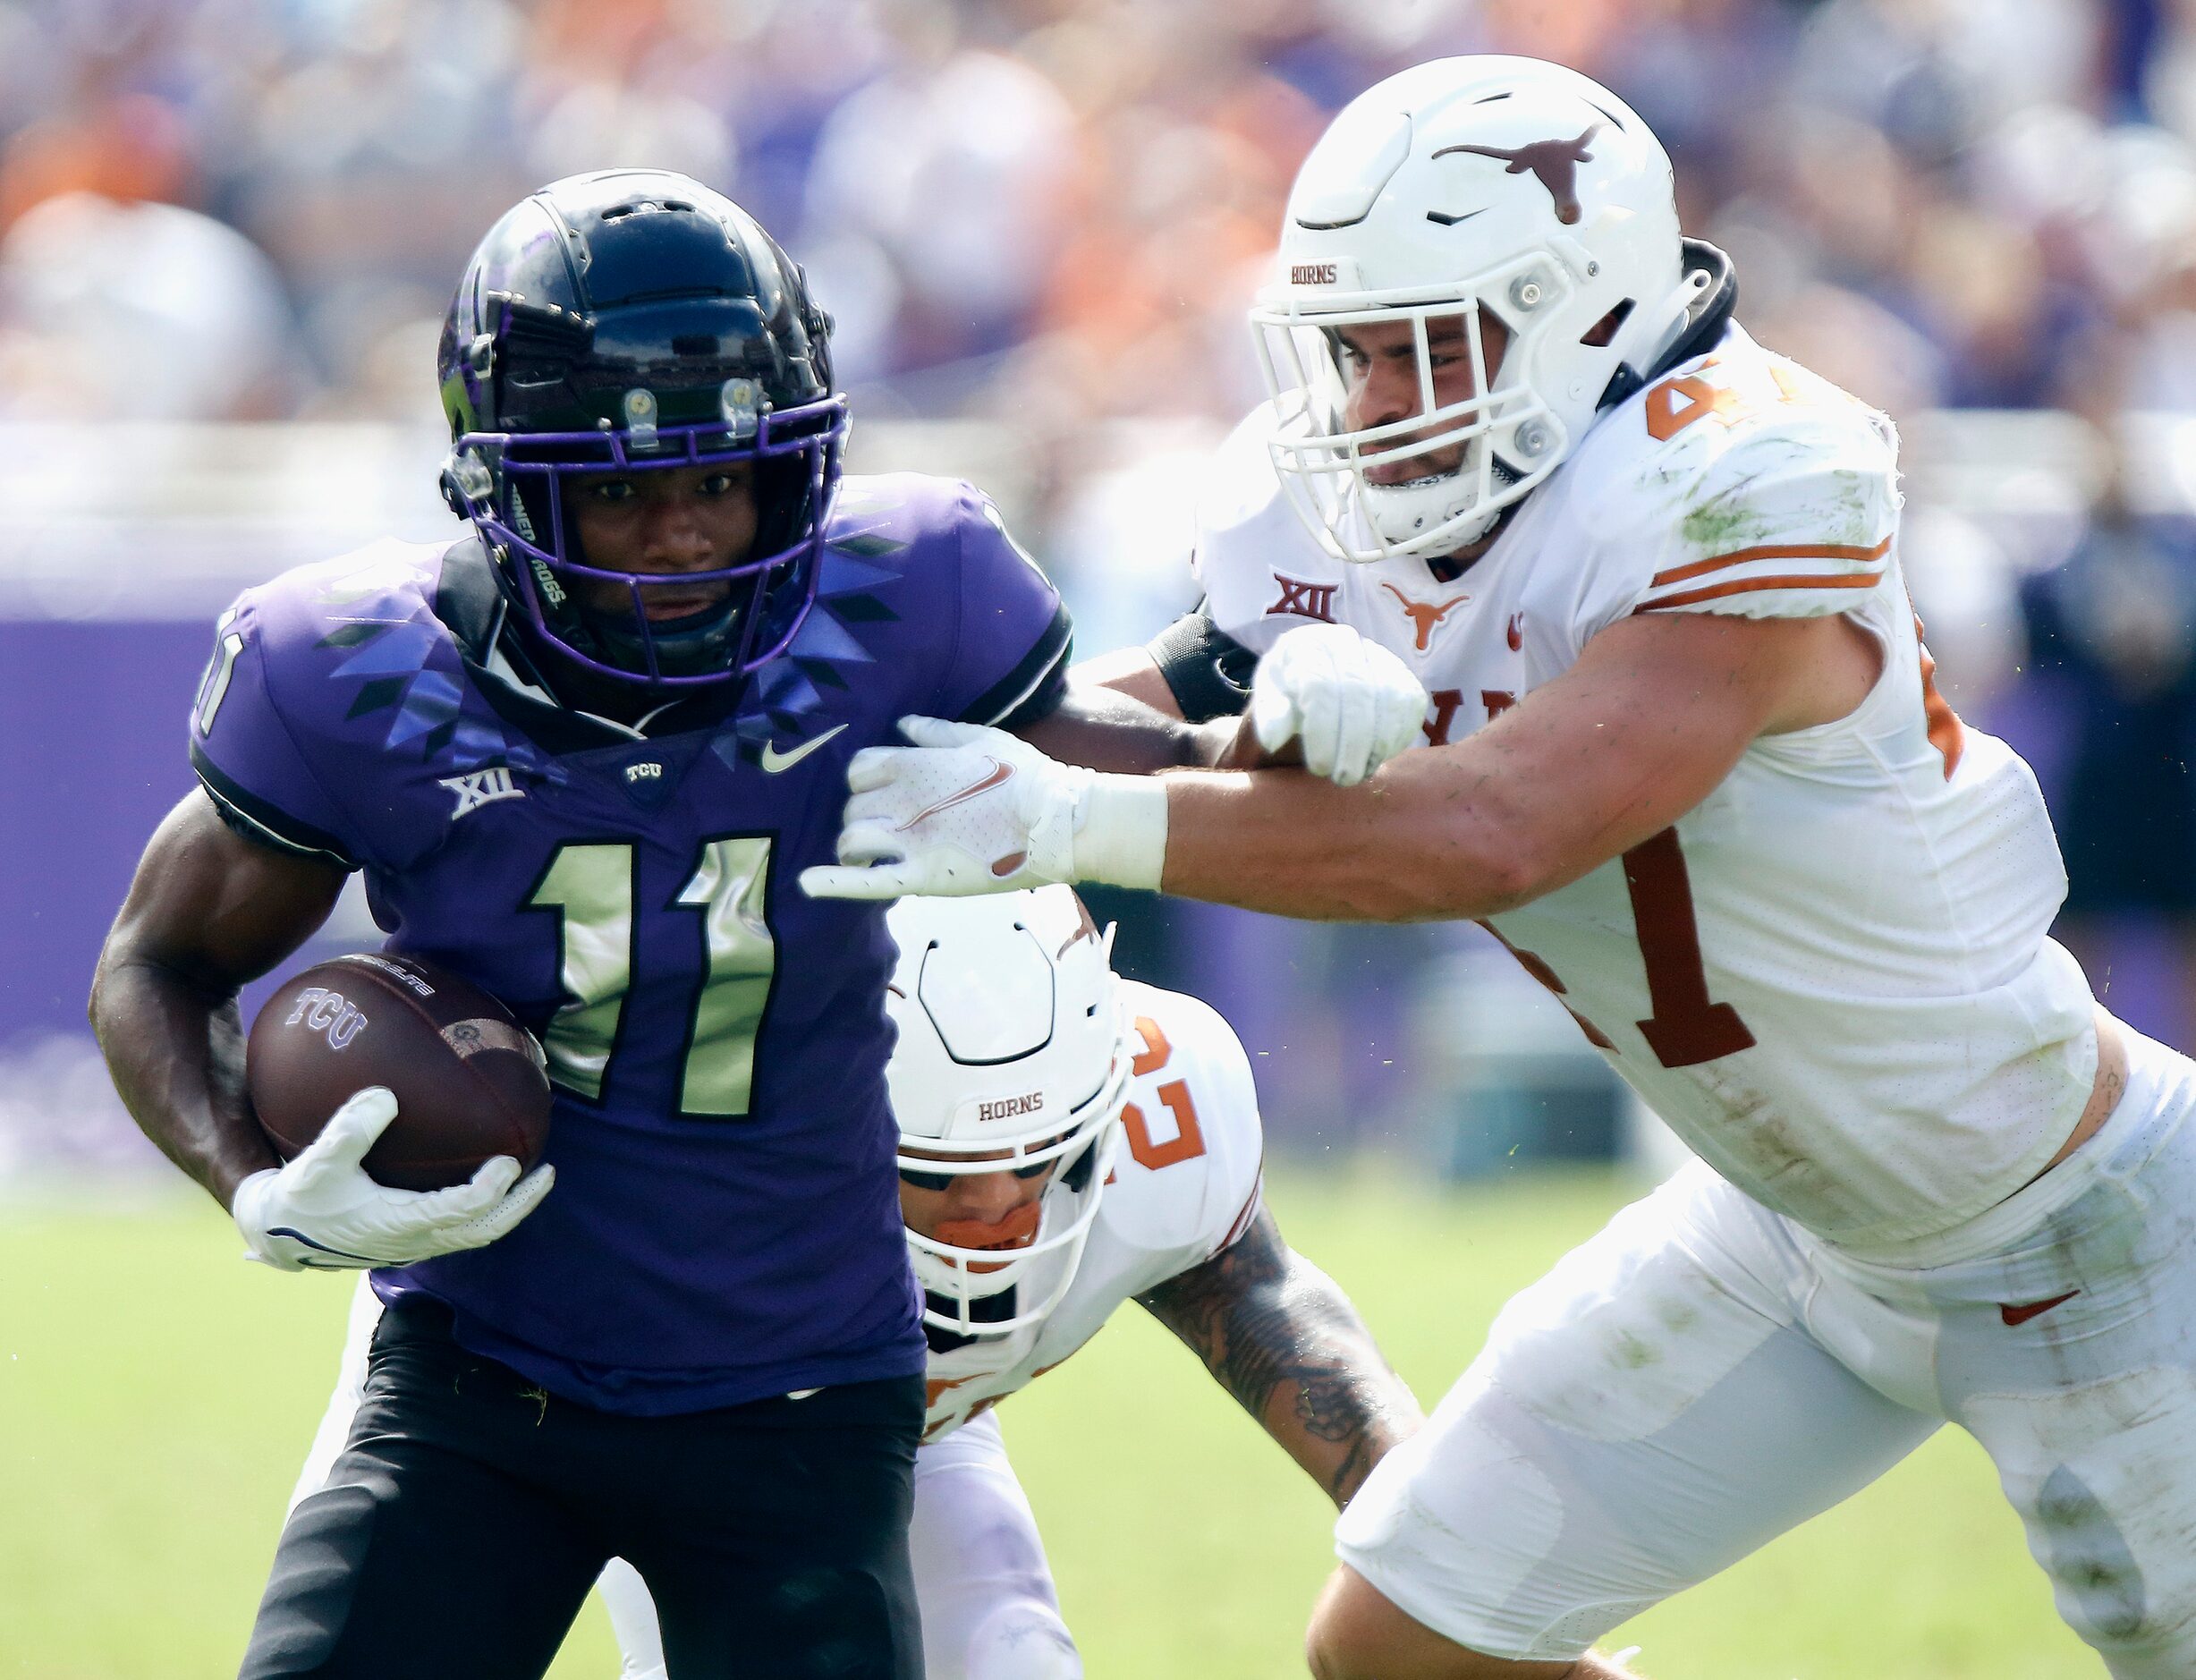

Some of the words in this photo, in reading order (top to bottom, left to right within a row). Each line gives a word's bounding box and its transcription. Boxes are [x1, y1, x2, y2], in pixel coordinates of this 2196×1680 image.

[1291, 263, 1337, 285] HORNS
[1265, 572, 1340, 624] XII
[438, 767, 526, 821] XII
[627, 763, 663, 782] TCU
[524, 834, 776, 1118] 11
[285, 987, 369, 1050] TCU
[979, 1090, 1044, 1122] HORNS
